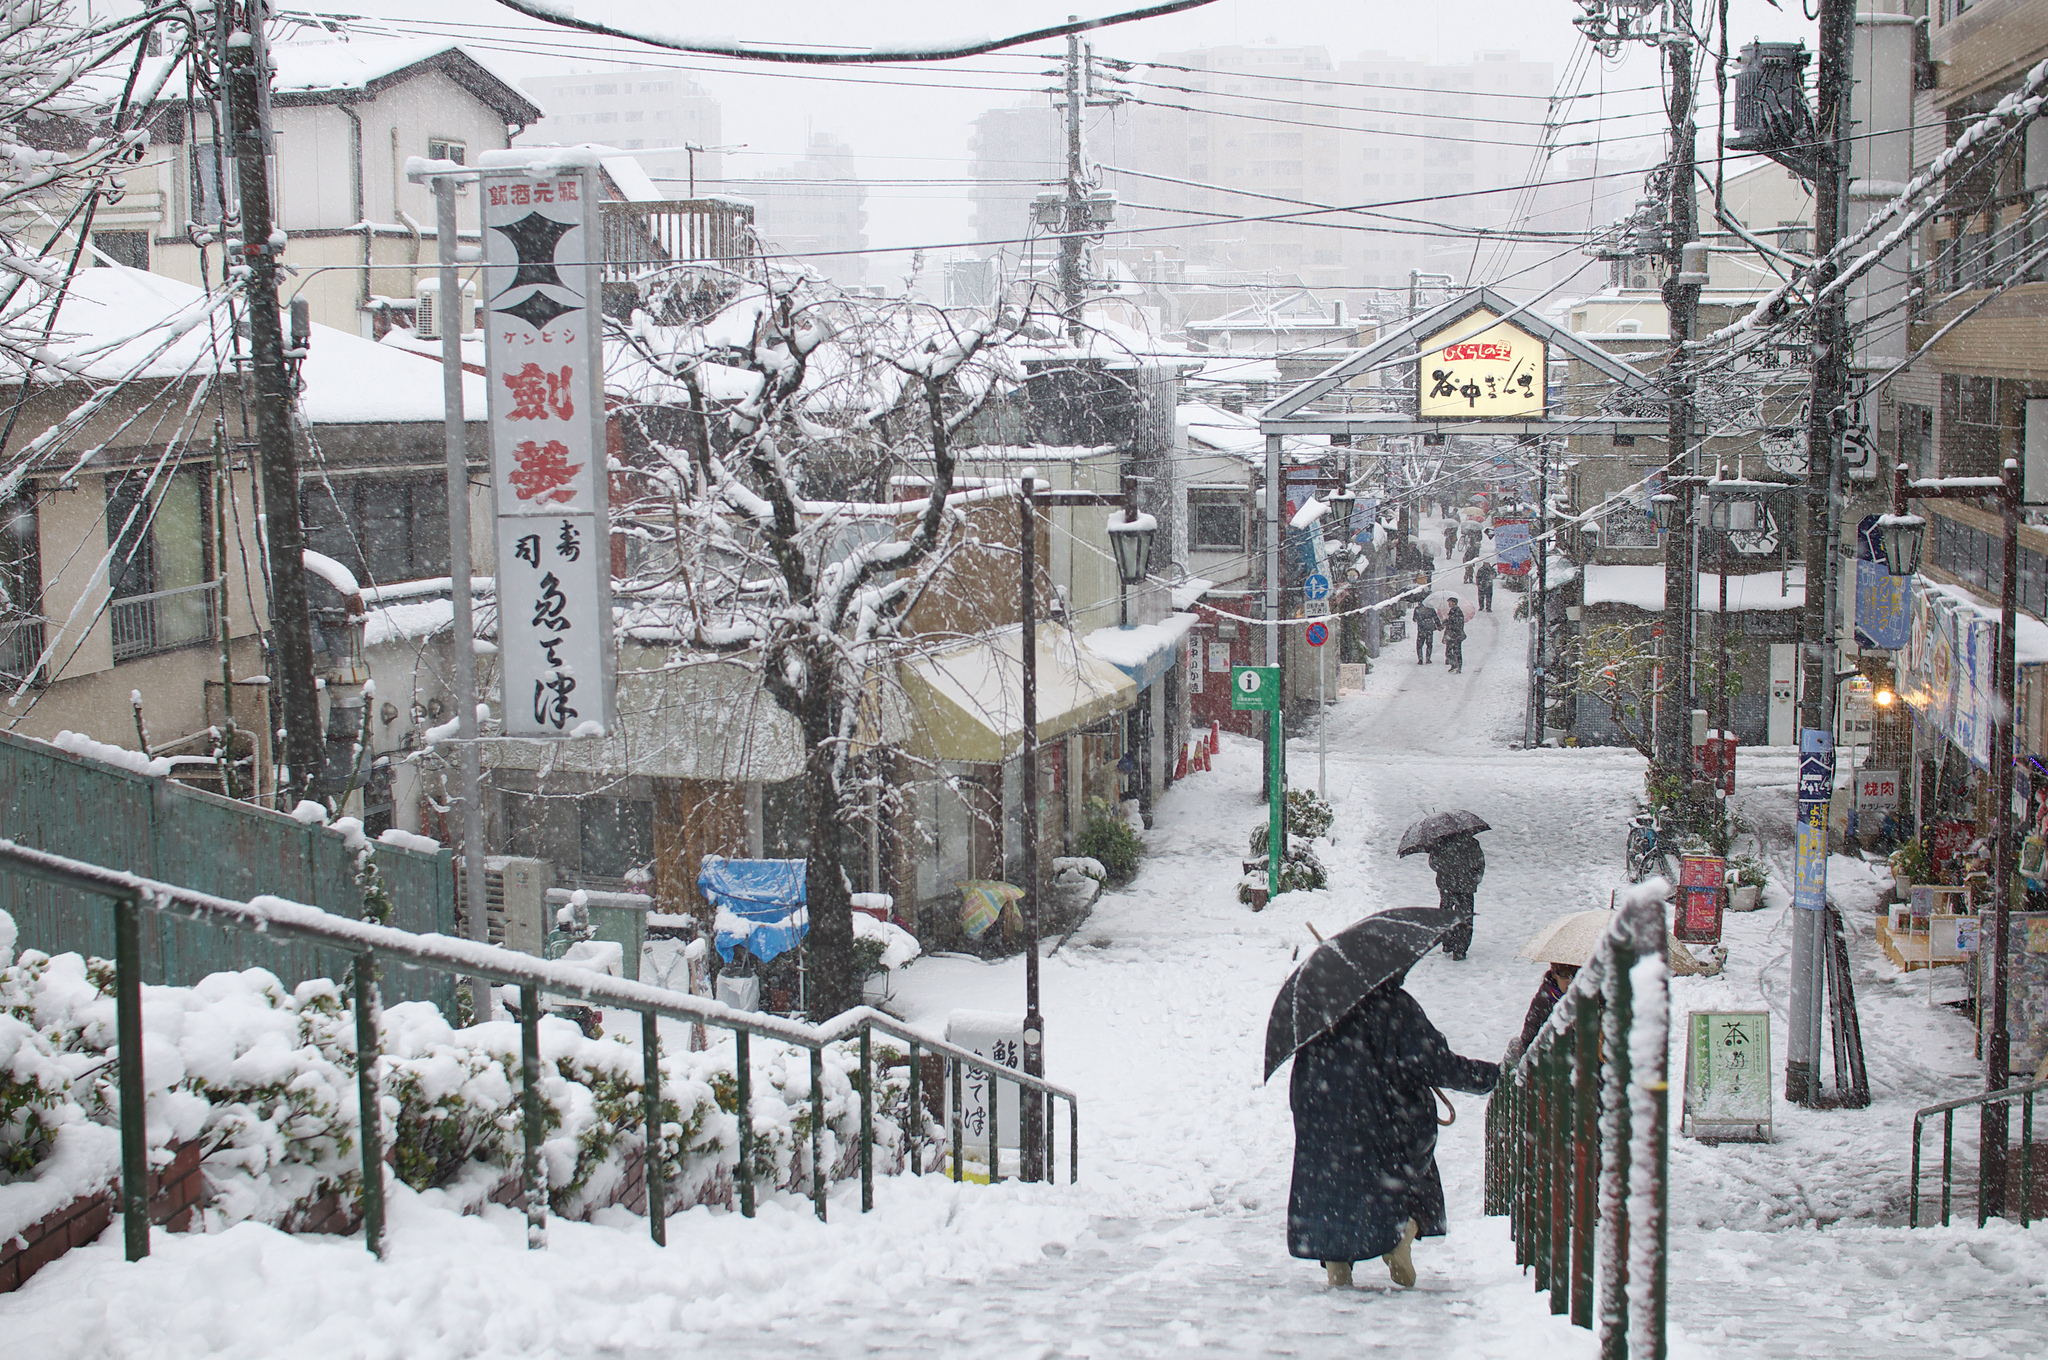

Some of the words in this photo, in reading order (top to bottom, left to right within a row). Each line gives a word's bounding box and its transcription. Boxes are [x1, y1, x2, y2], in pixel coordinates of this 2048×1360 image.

[503, 328, 577, 345] ケンビシ
[1444, 340, 1511, 362] ひぐらしの里
[1429, 357, 1536, 408] 谷中ぎんざ
[515, 519, 581, 569] 寿司
[1878, 576, 1891, 630] クリニック
[1864, 781, 1895, 796] 焼肉
[1808, 804, 1820, 863] よみせ通り
